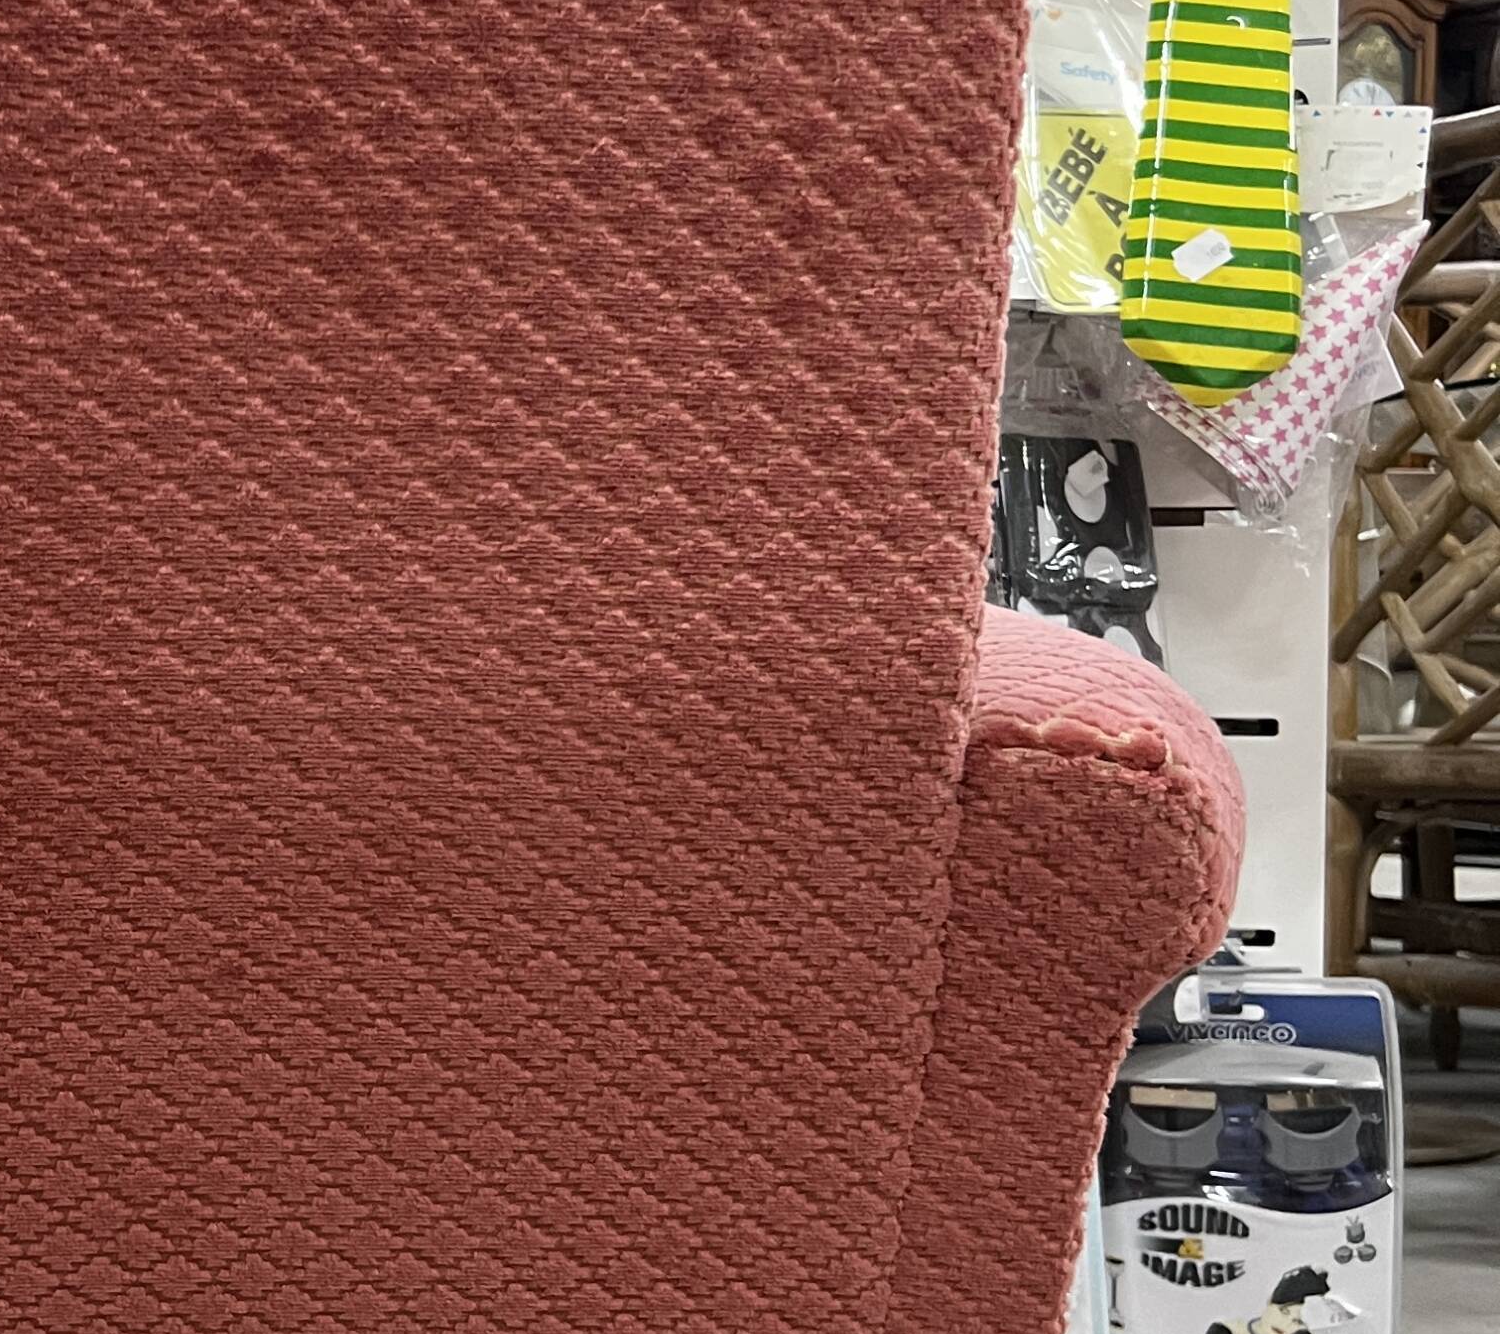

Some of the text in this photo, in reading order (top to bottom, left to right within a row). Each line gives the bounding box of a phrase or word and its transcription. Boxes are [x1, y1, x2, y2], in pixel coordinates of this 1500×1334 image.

[1060, 61, 1115, 85] Safety
[1039, 127, 1107, 227] BÉBÉ
[1138, 1202, 1250, 1238] SOUND
[1141, 1252, 1246, 1288] IMAGE
